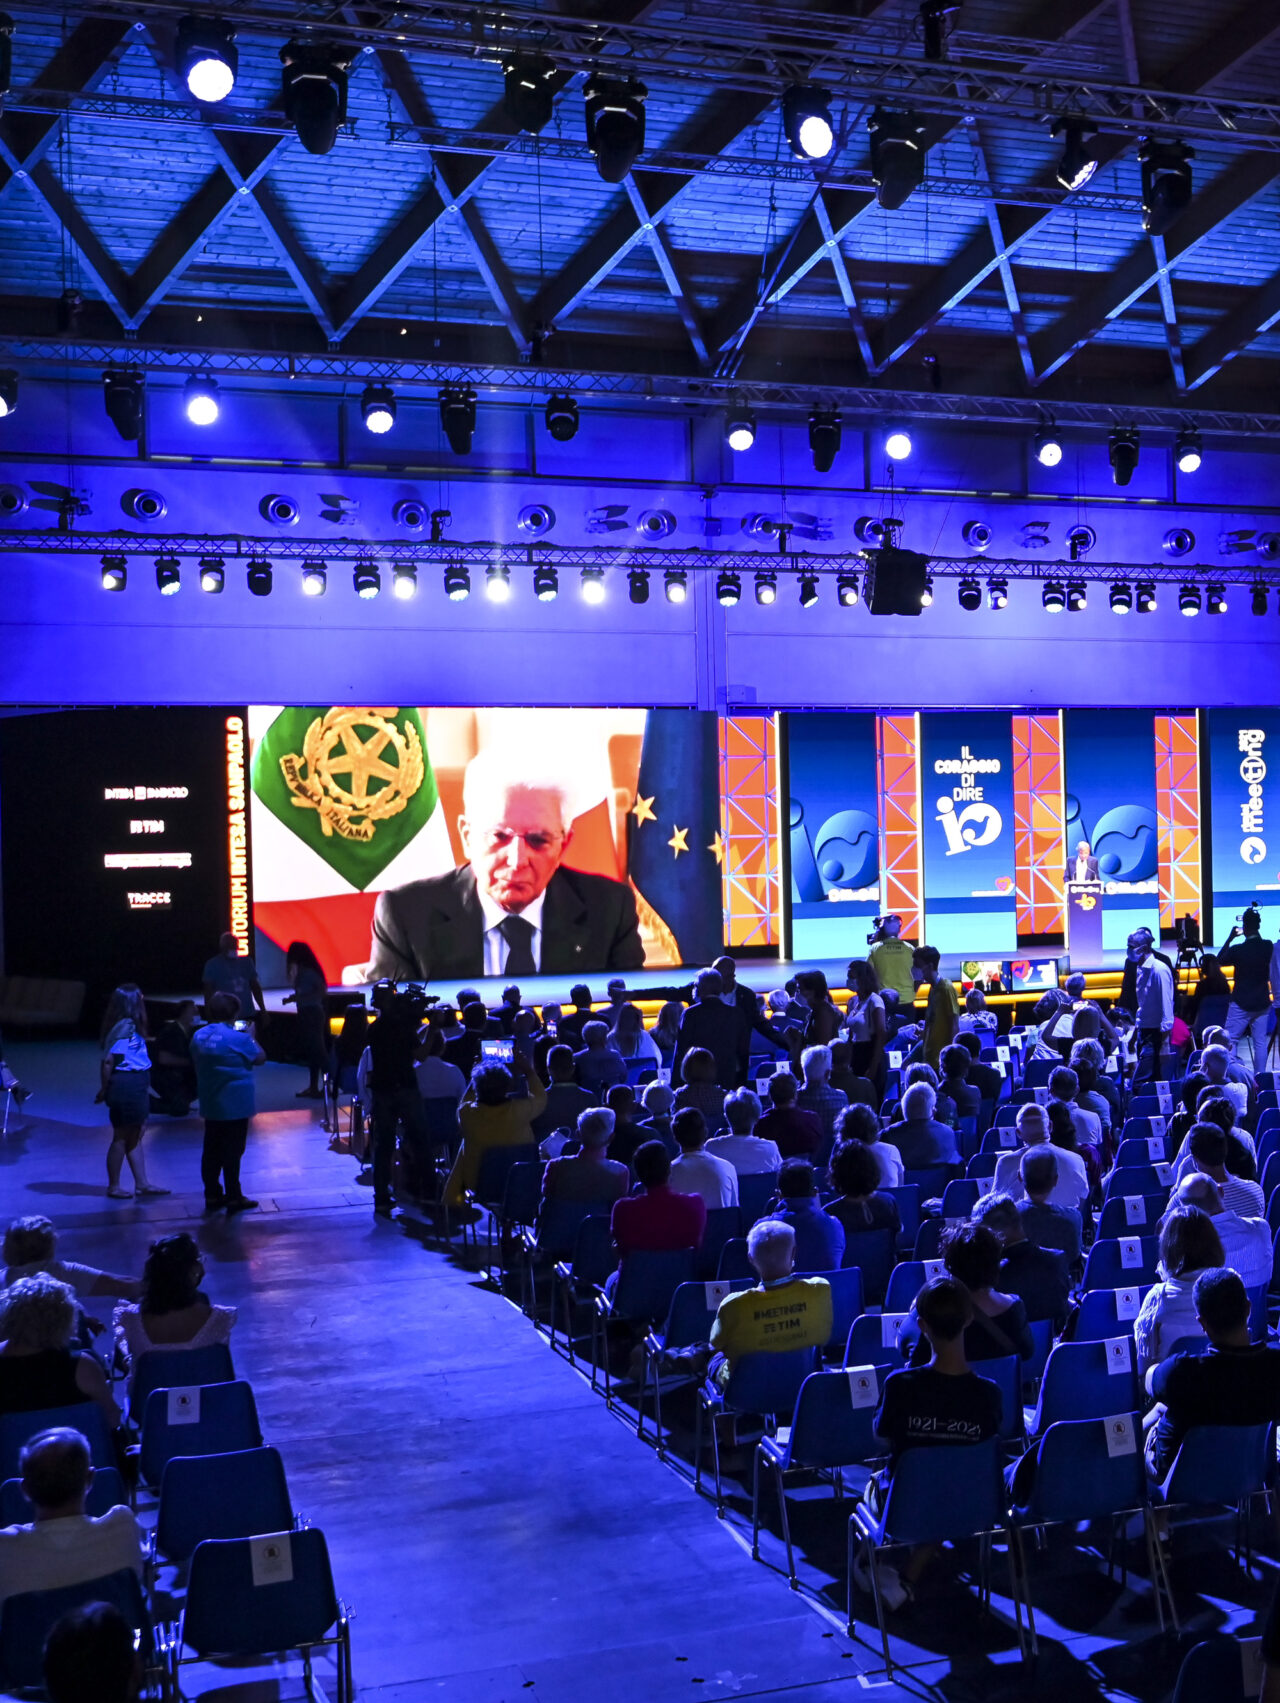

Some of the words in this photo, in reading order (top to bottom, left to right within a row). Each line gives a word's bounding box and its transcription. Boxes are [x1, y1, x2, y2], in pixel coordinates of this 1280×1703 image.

[960, 745, 974, 760] IL
[934, 759, 1001, 774] CORAGGIO
[960, 773, 975, 788] DI
[952, 787, 984, 801] DIRE
[326, 809, 370, 839] ITALIANA
[777, 1318, 801, 1332] TIM
